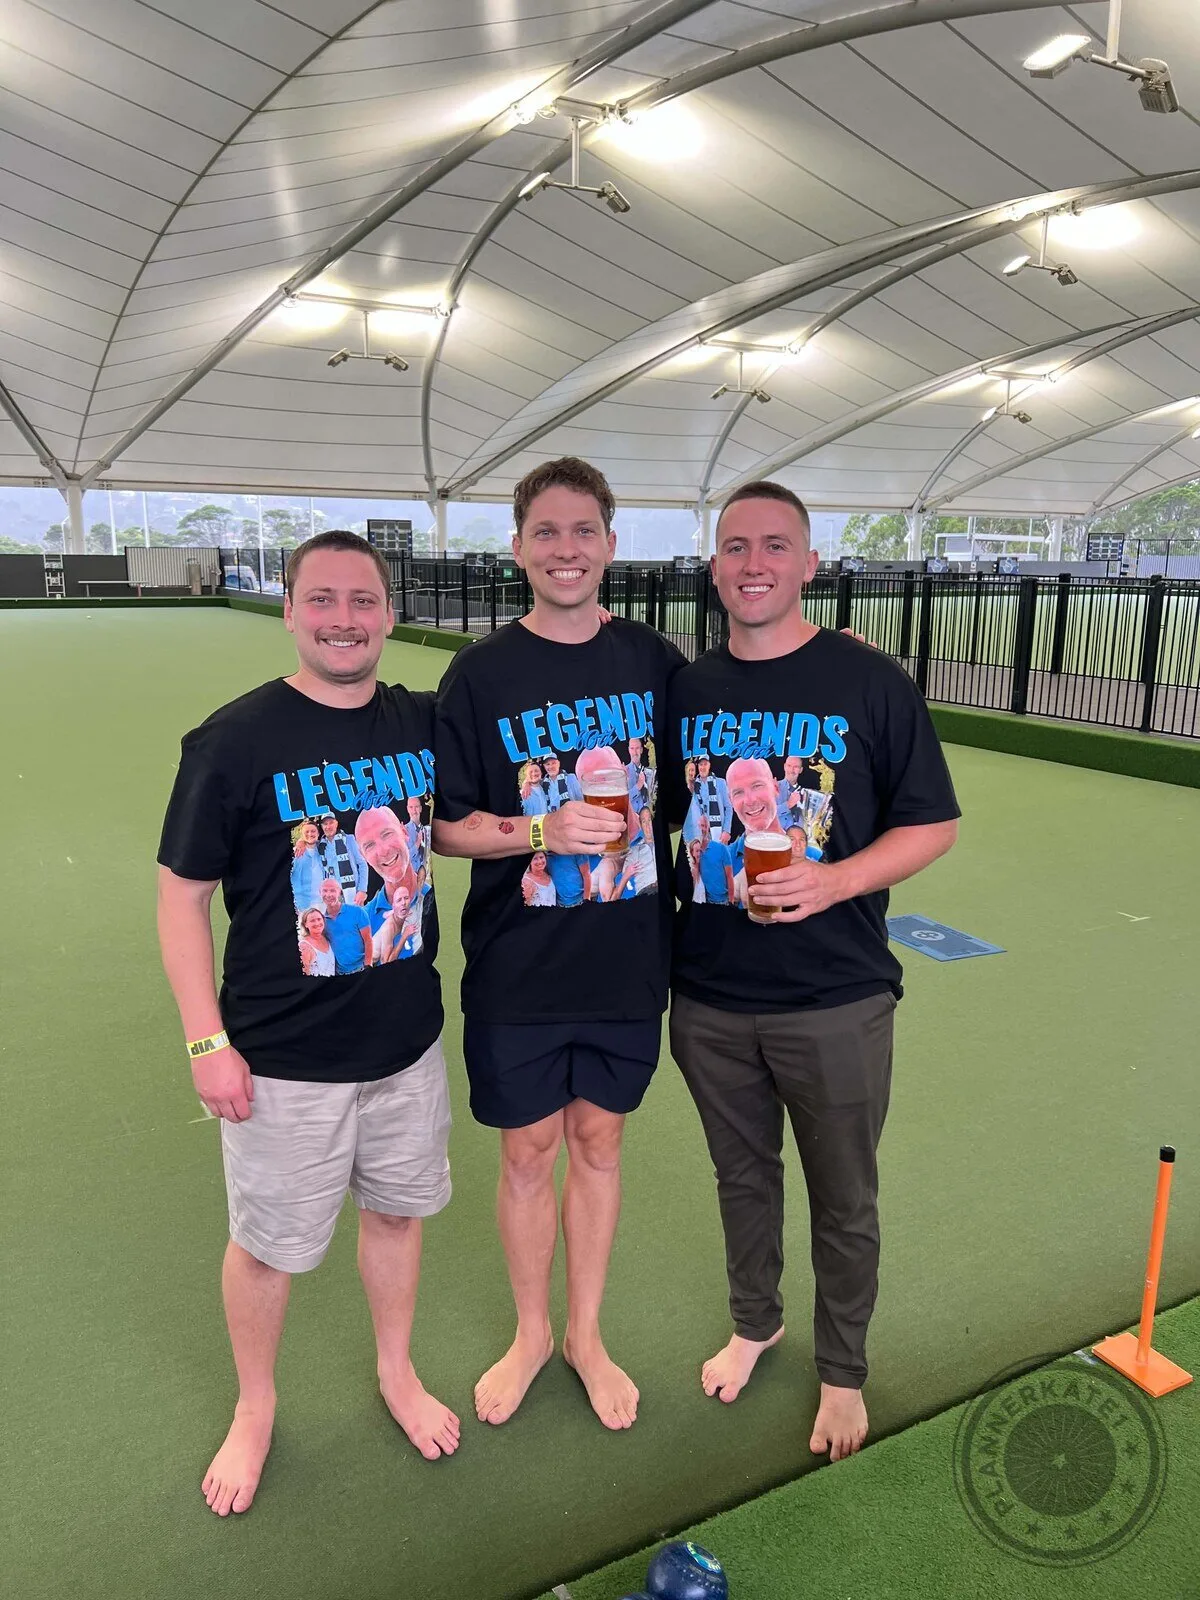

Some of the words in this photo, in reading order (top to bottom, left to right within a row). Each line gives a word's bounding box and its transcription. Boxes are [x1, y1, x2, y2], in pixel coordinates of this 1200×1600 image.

[496, 691, 654, 763] LEGENDS
[681, 711, 849, 764] LEGENDS
[272, 749, 436, 822] LEGENDS
[532, 823, 543, 847] VIP
[190, 1038, 216, 1056] VIP
